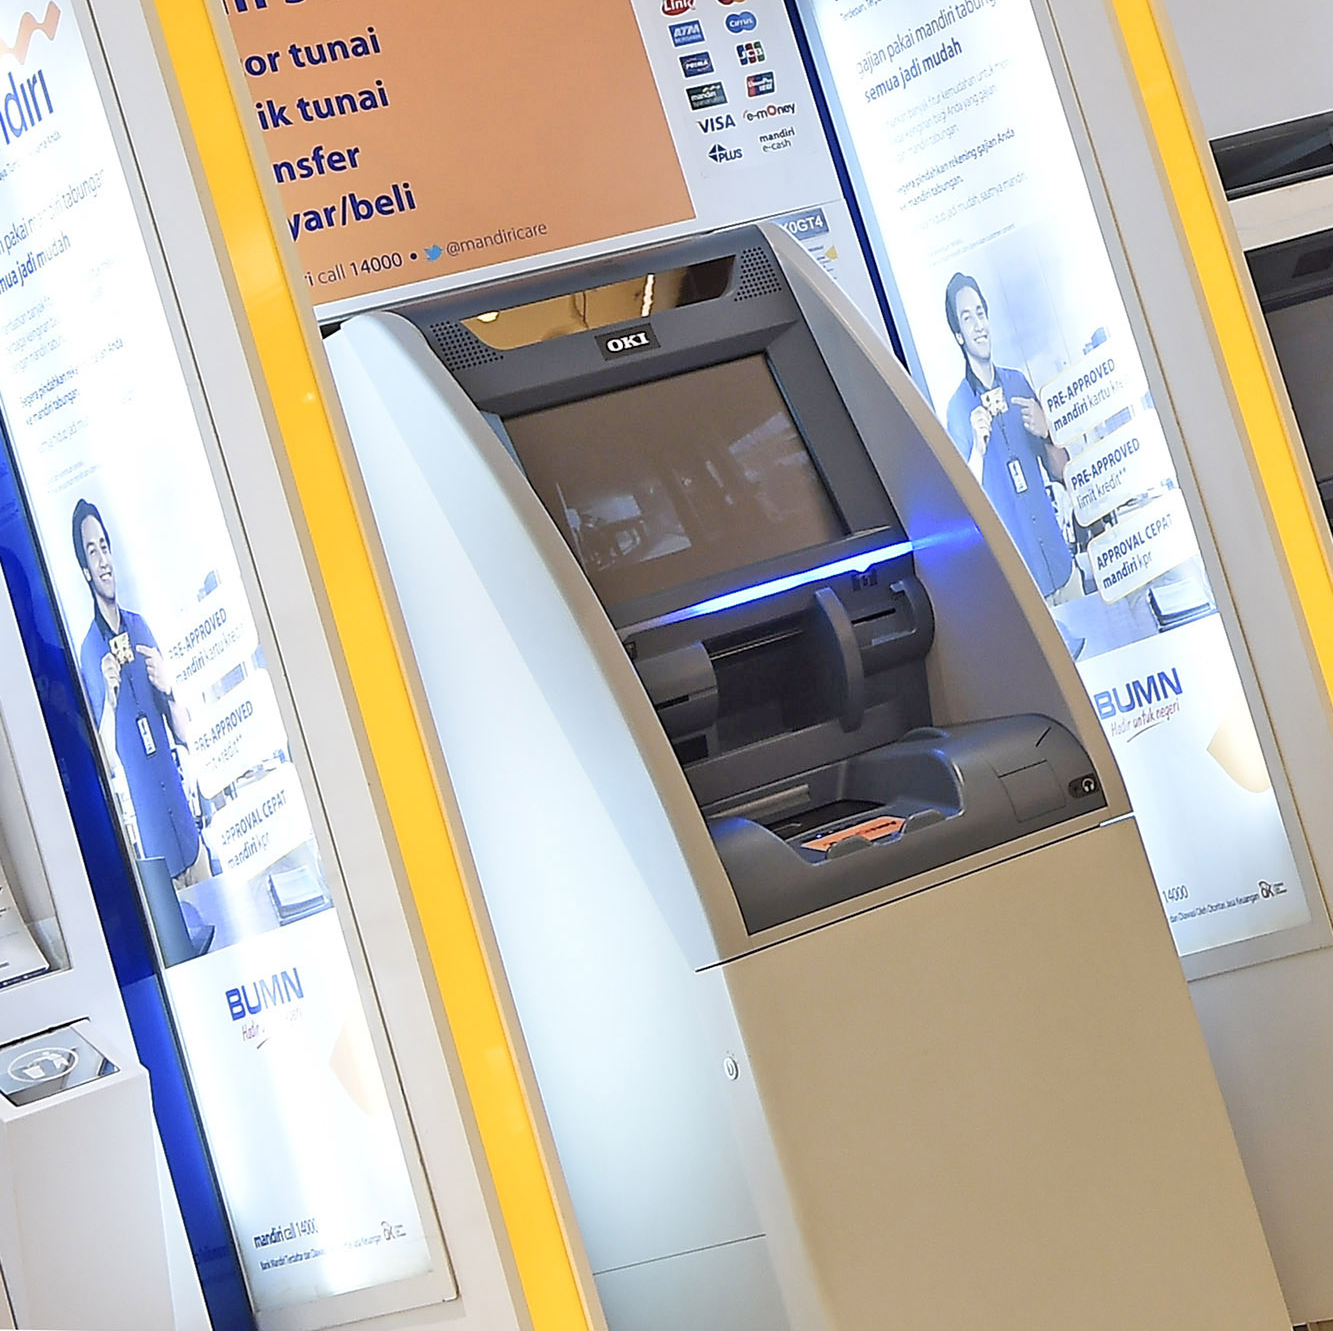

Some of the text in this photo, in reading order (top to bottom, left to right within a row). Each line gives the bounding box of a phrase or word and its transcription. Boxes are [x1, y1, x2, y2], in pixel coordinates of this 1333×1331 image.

[243, 26, 381, 77] or tunai
[886, 4, 956, 63] pakai mandiri
[864, 36, 963, 104] semua jadi mudah
[297, 79, 390, 122] tunai
[698, 114, 736, 134] VISA
[759, 127, 796, 143] mandiri
[273, 144, 360, 183] nsfer
[719, 148, 743, 163] PLUS
[762, 139, 792, 153] e-cash
[288, 182, 416, 241] yar/beli
[16, 252, 38, 287] jadi
[318, 221, 548, 286] call 14000 @mandiricare
[607, 332, 649, 352] OKI
[1047, 358, 1116, 413] PRE-APPROVED
[1053, 400, 1089, 432] mandiri
[1071, 437, 1141, 491] PRE-APPROVED
[1076, 489, 1098, 511] limit
[1096, 513, 1173, 571] APPROVAL CEPAT
[1102, 557, 1138, 590] mandiri
[1093, 667, 1183, 720] BUMN
[262, 789, 287, 817] CEPAT
[225, 967, 304, 1021] BUMN
[253, 1225, 284, 1249] mandiri
